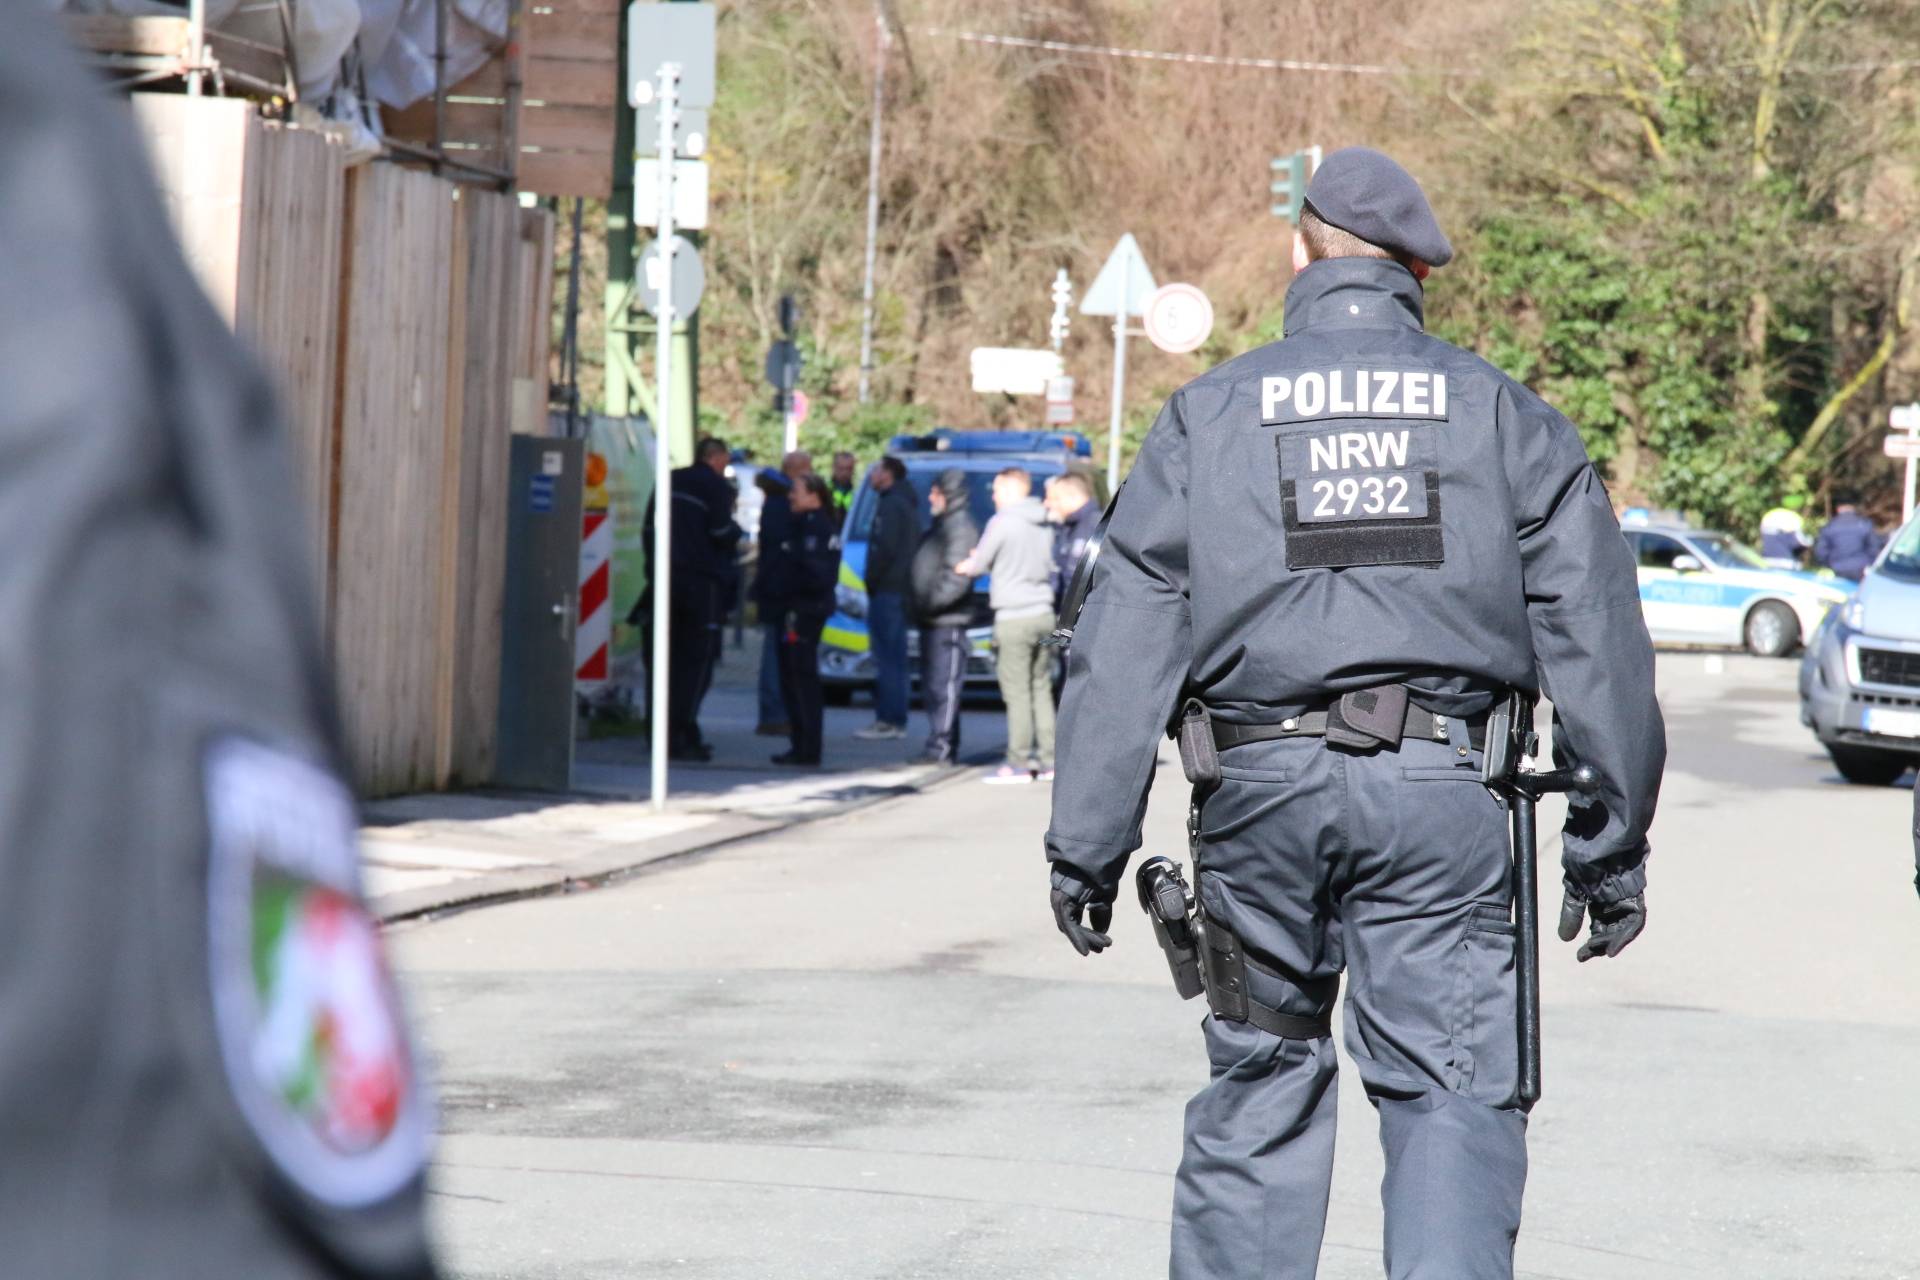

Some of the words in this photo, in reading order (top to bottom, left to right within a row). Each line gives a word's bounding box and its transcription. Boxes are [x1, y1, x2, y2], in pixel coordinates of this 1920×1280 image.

[1262, 370, 1446, 420] POLIZEI
[1310, 431, 1410, 472] NRW
[1312, 476, 1410, 517] 2932
